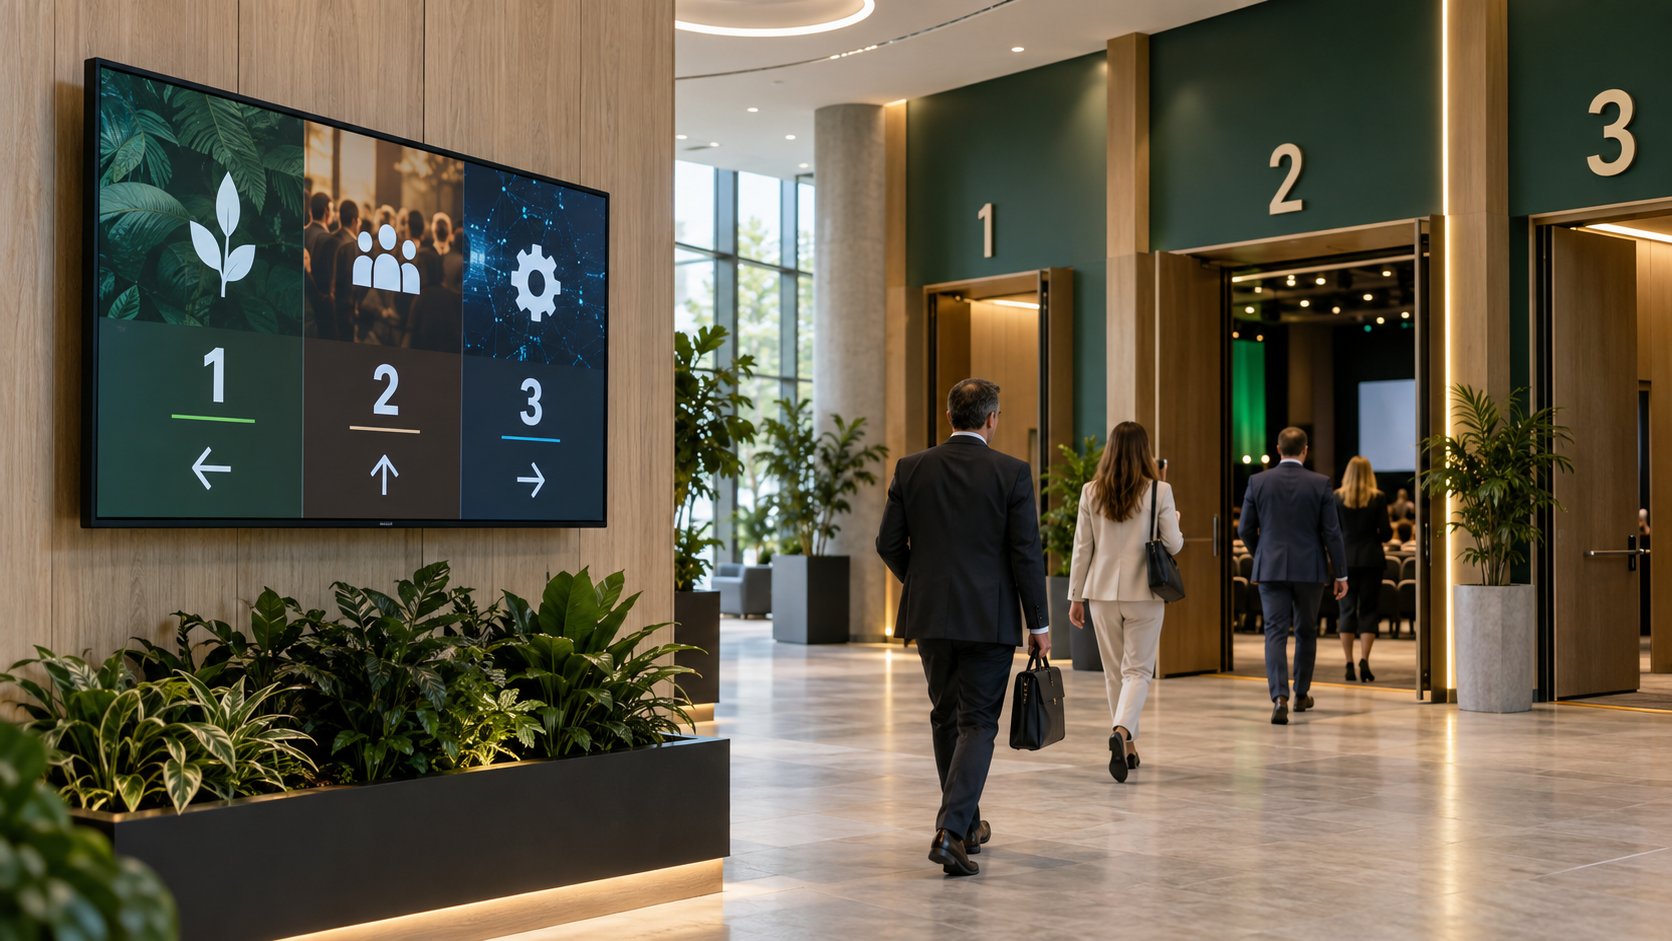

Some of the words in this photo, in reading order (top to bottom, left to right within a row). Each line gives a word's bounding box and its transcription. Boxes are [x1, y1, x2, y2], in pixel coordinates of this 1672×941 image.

[1587, 89, 1636, 176] 3
[1269, 143, 1303, 215] 2
[978, 203, 993, 258] 1
[204, 347, 225, 402] 1
[373, 364, 399, 416] 2
[520, 378, 543, 426] 3
